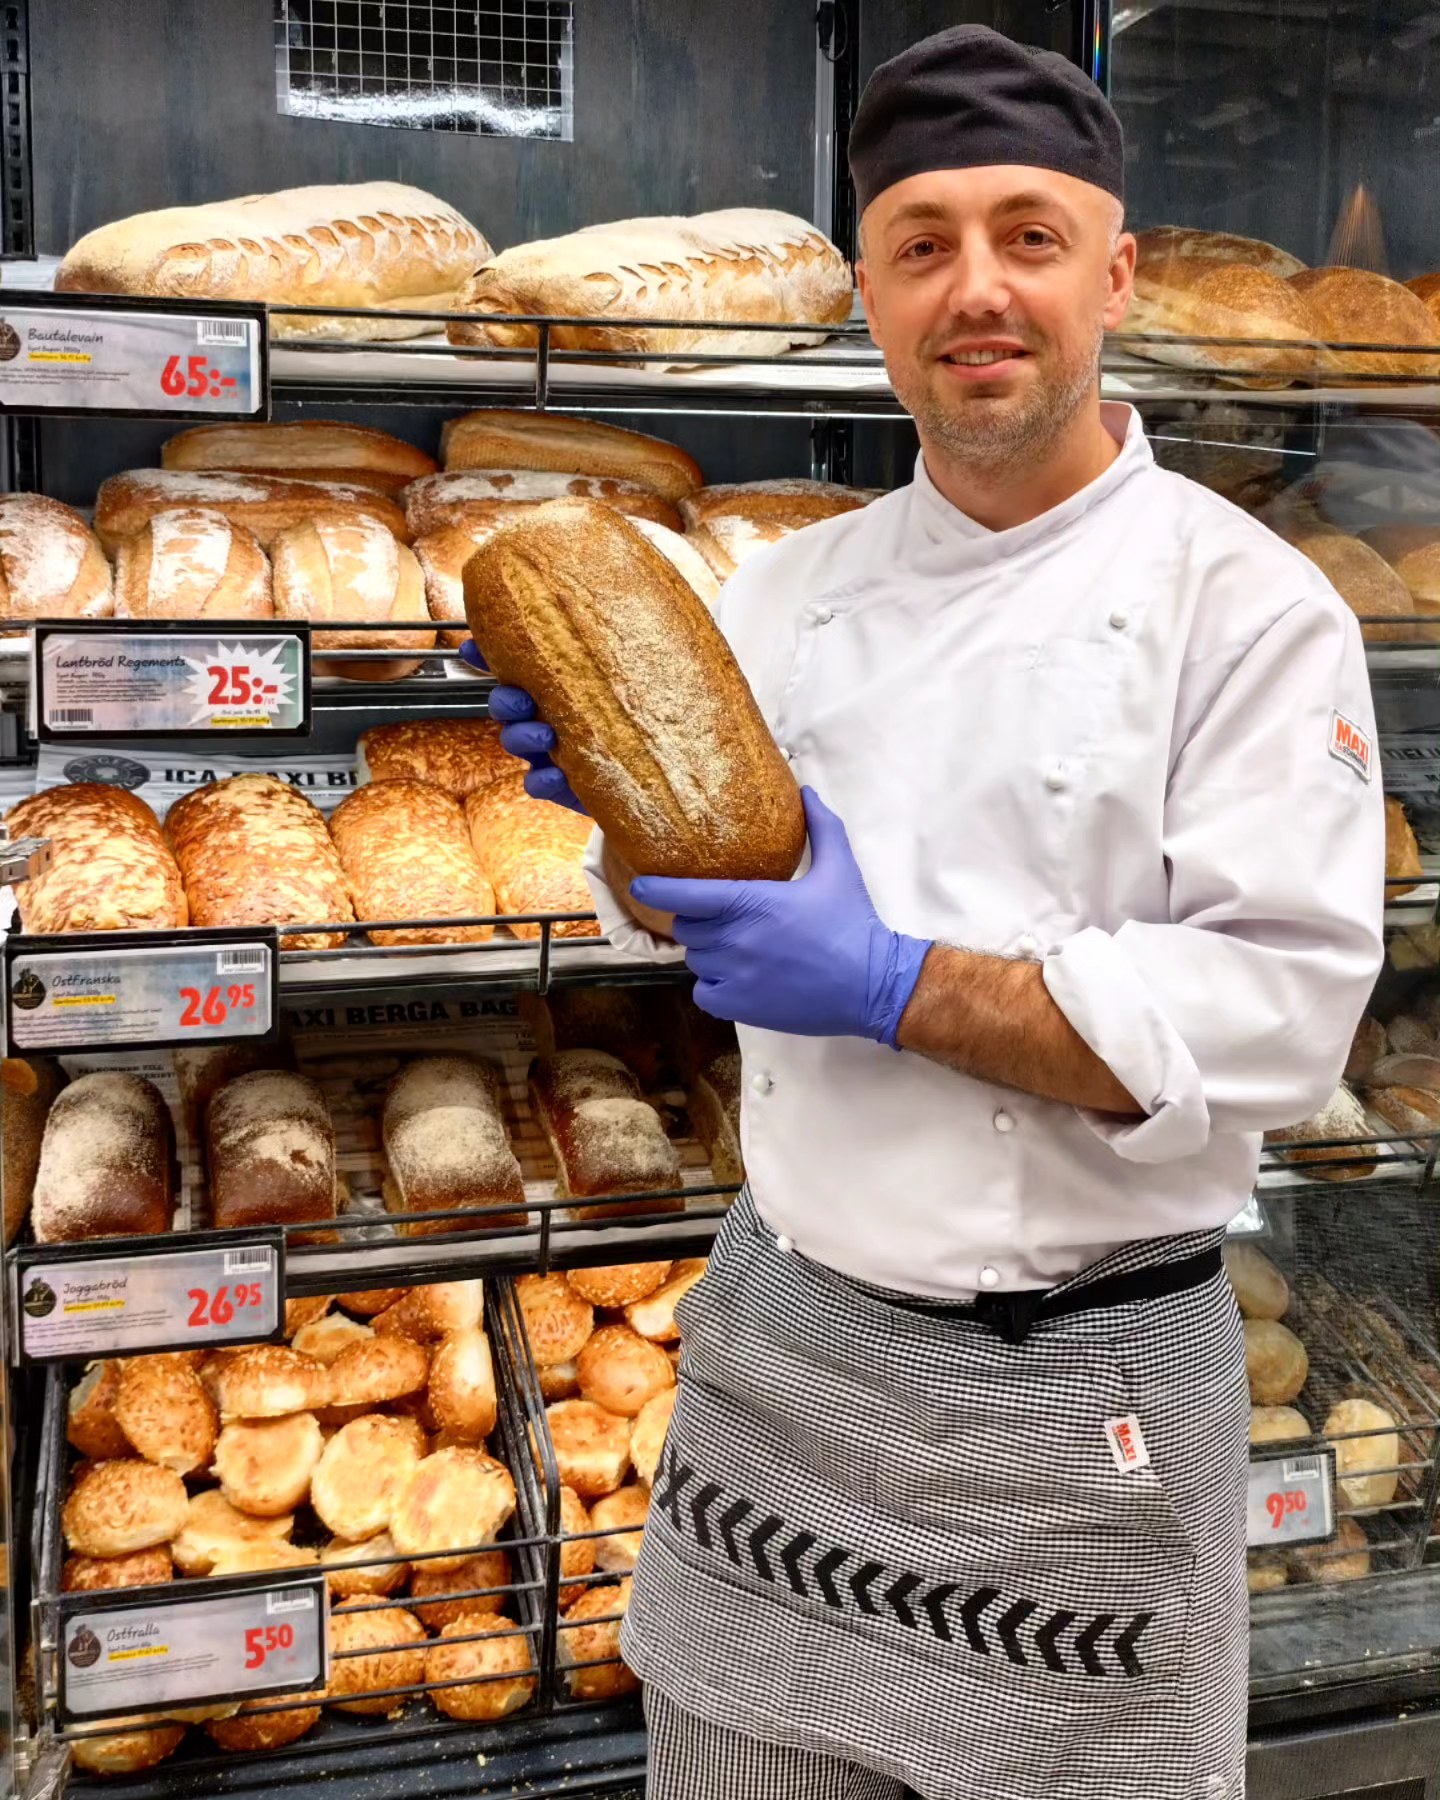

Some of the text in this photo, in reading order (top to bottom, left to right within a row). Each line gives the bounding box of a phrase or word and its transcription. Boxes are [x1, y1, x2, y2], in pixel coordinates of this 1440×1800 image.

[28, 328, 103, 343] Bautalevain
[160, 355, 237, 398] 65:-
[56, 655, 186, 672] Lantbröd Regements
[207, 665, 278, 706] 25:-
[1336, 718, 1369, 764] MAXI
[165, 769, 218, 784] ICA
[287, 1007, 335, 1028] AXI
[346, 1001, 450, 1026] BERGA
[1118, 1423, 1137, 1461] MAXI
